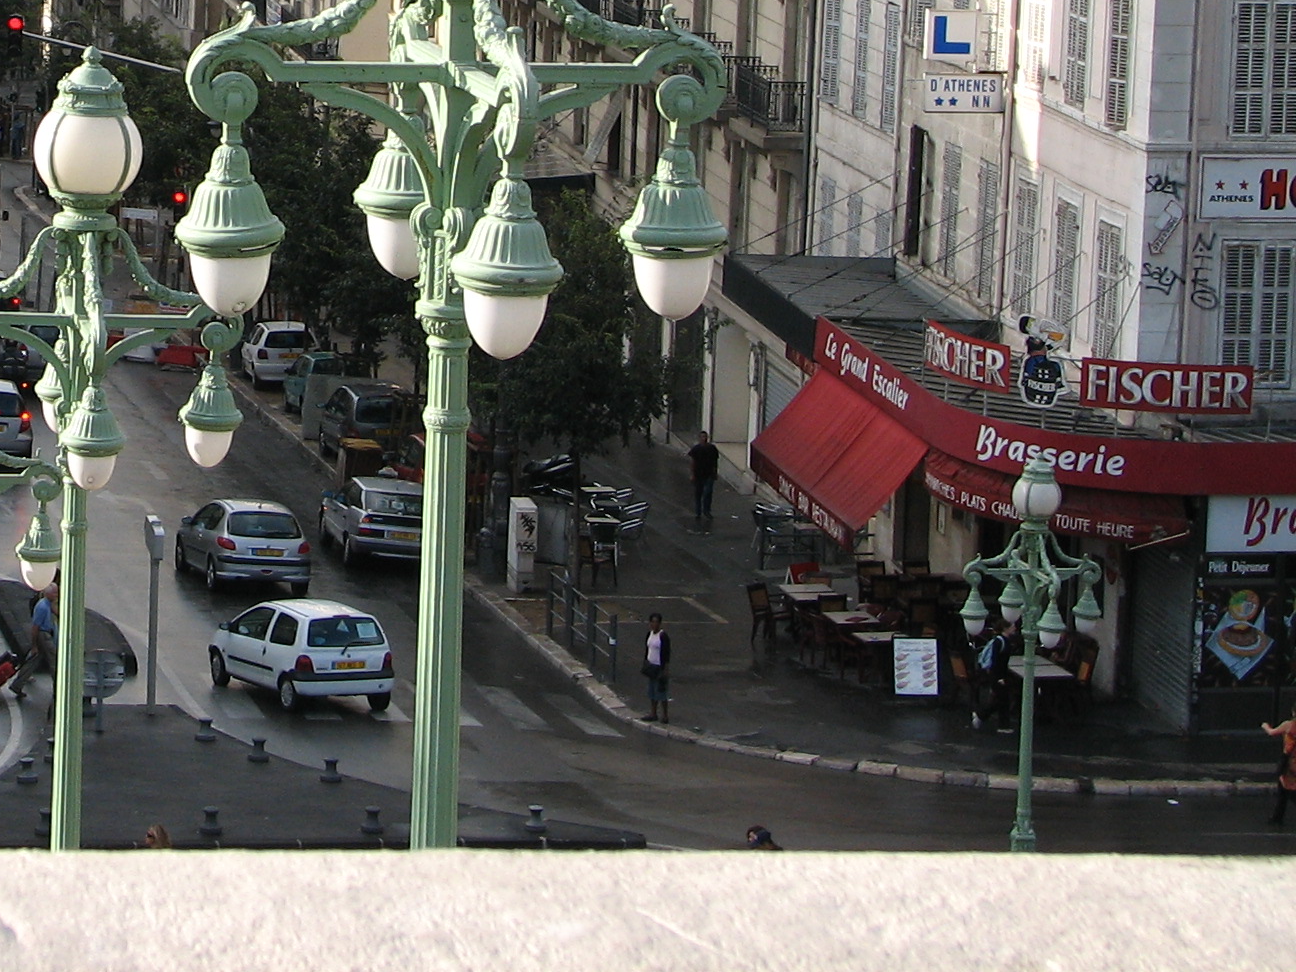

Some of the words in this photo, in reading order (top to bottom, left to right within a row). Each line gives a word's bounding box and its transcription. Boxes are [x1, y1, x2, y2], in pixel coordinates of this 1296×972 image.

[930, 77, 997, 94] D'ATHENES
[1209, 194, 1254, 203] ATHENES
[1259, 168, 1296, 210] H
[825, 333, 836, 360] Le
[840, 343, 869, 383] Grand
[872, 364, 910, 411] Escalier
[924, 325, 1005, 388] FISCHER
[1087, 364, 1249, 409] FISCHER
[975, 424, 1126, 477] Brasserie
[961, 491, 987, 512] PLATS
[1055, 513, 1091, 533] TOUTE
[1096, 521, 1135, 539] HEURE
[1208, 561, 1228, 573] Petit
